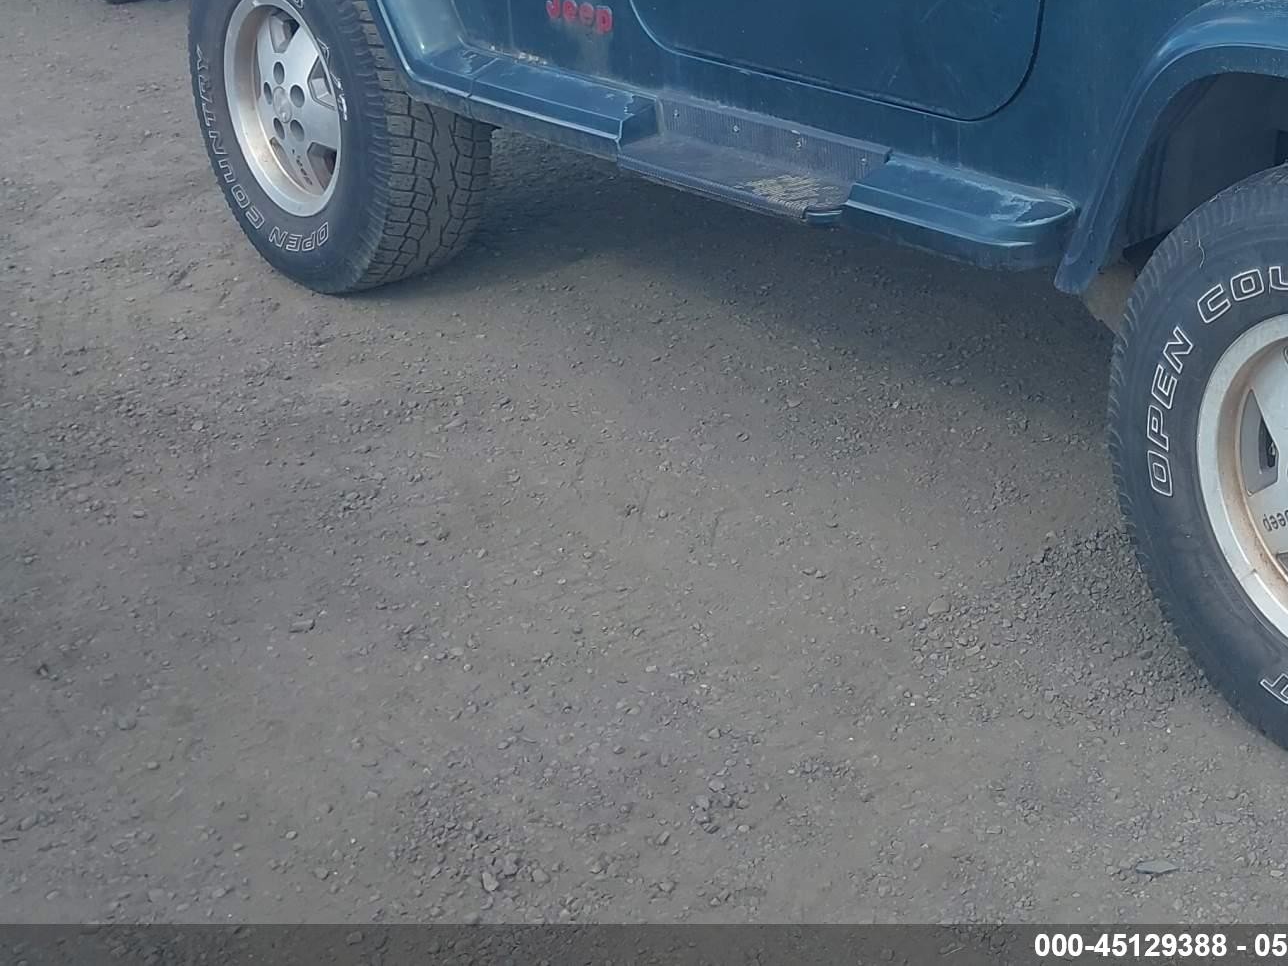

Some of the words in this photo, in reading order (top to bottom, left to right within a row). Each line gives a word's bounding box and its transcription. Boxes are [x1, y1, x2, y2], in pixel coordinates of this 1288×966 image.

[196, 43, 265, 230] COUNTRY
[269, 222, 329, 252] OPEN
[1146, 325, 1194, 497] OPEN
